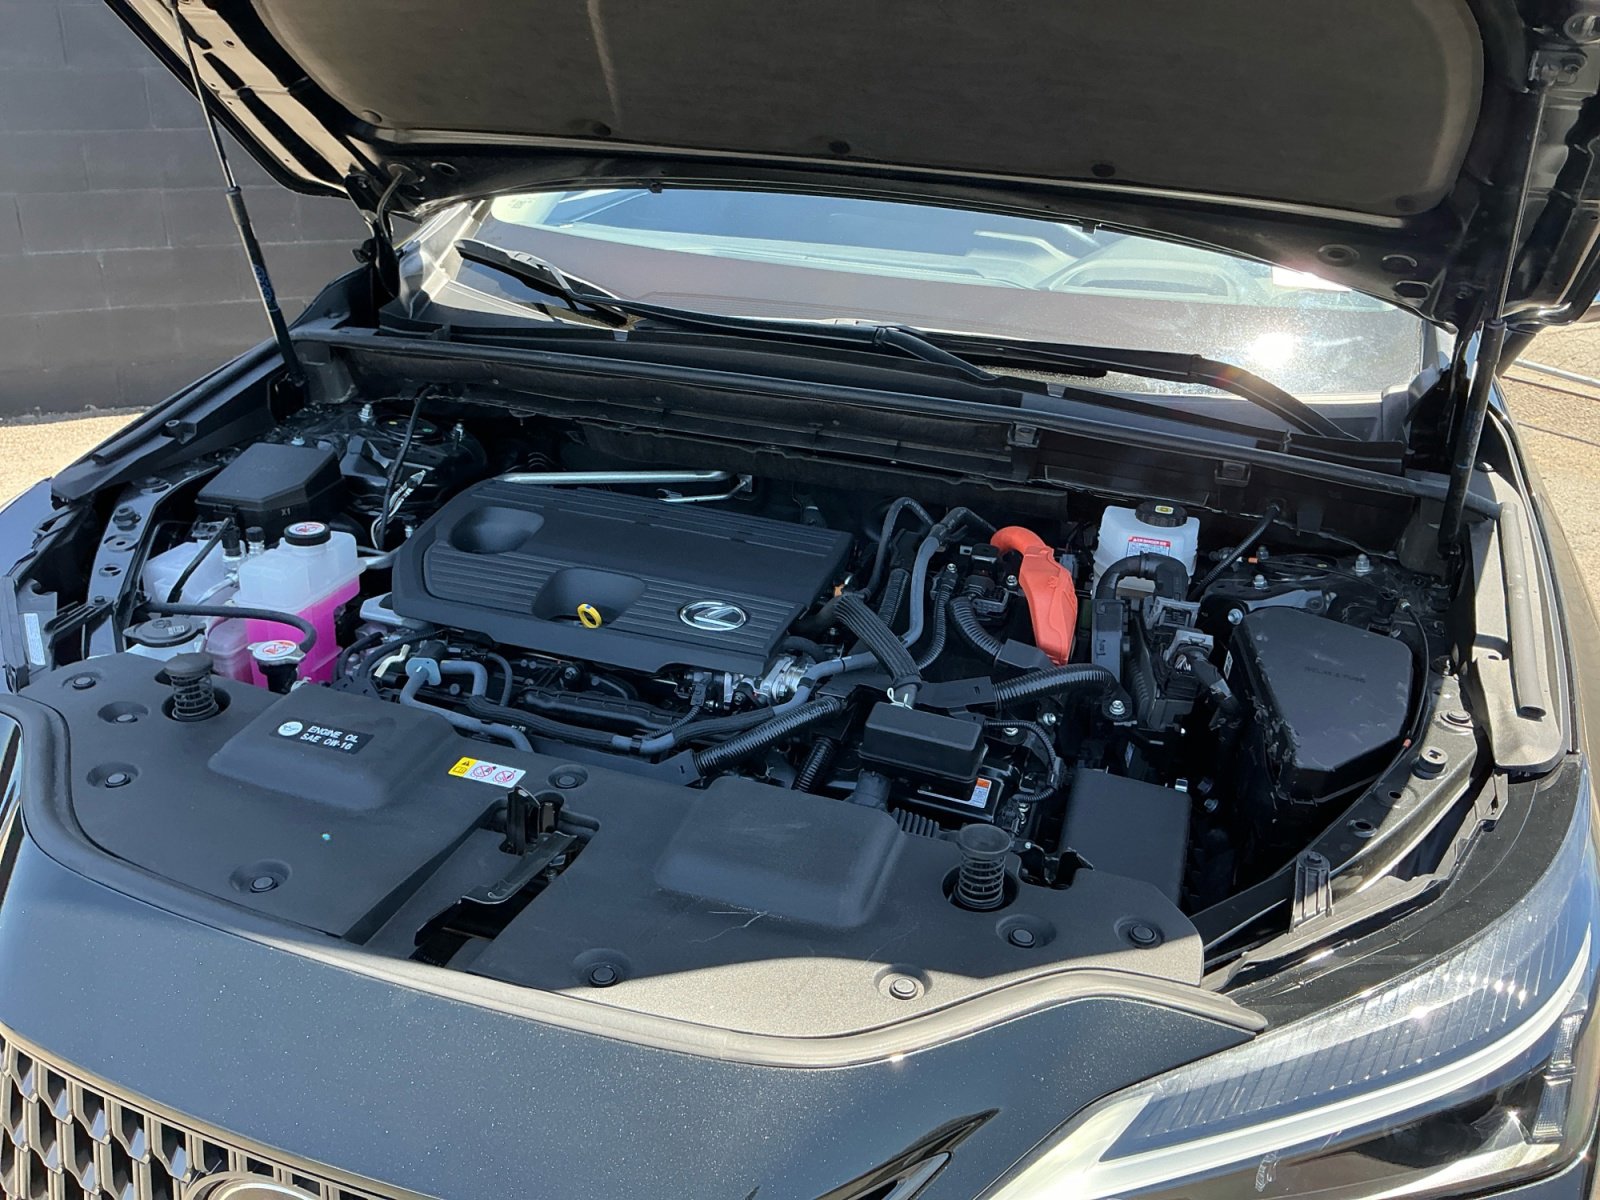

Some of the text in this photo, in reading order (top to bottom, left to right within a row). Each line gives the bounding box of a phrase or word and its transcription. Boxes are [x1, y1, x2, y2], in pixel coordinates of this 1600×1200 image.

[300, 733, 322, 743] SAE
[307, 725, 359, 743] ENGINE OIL
